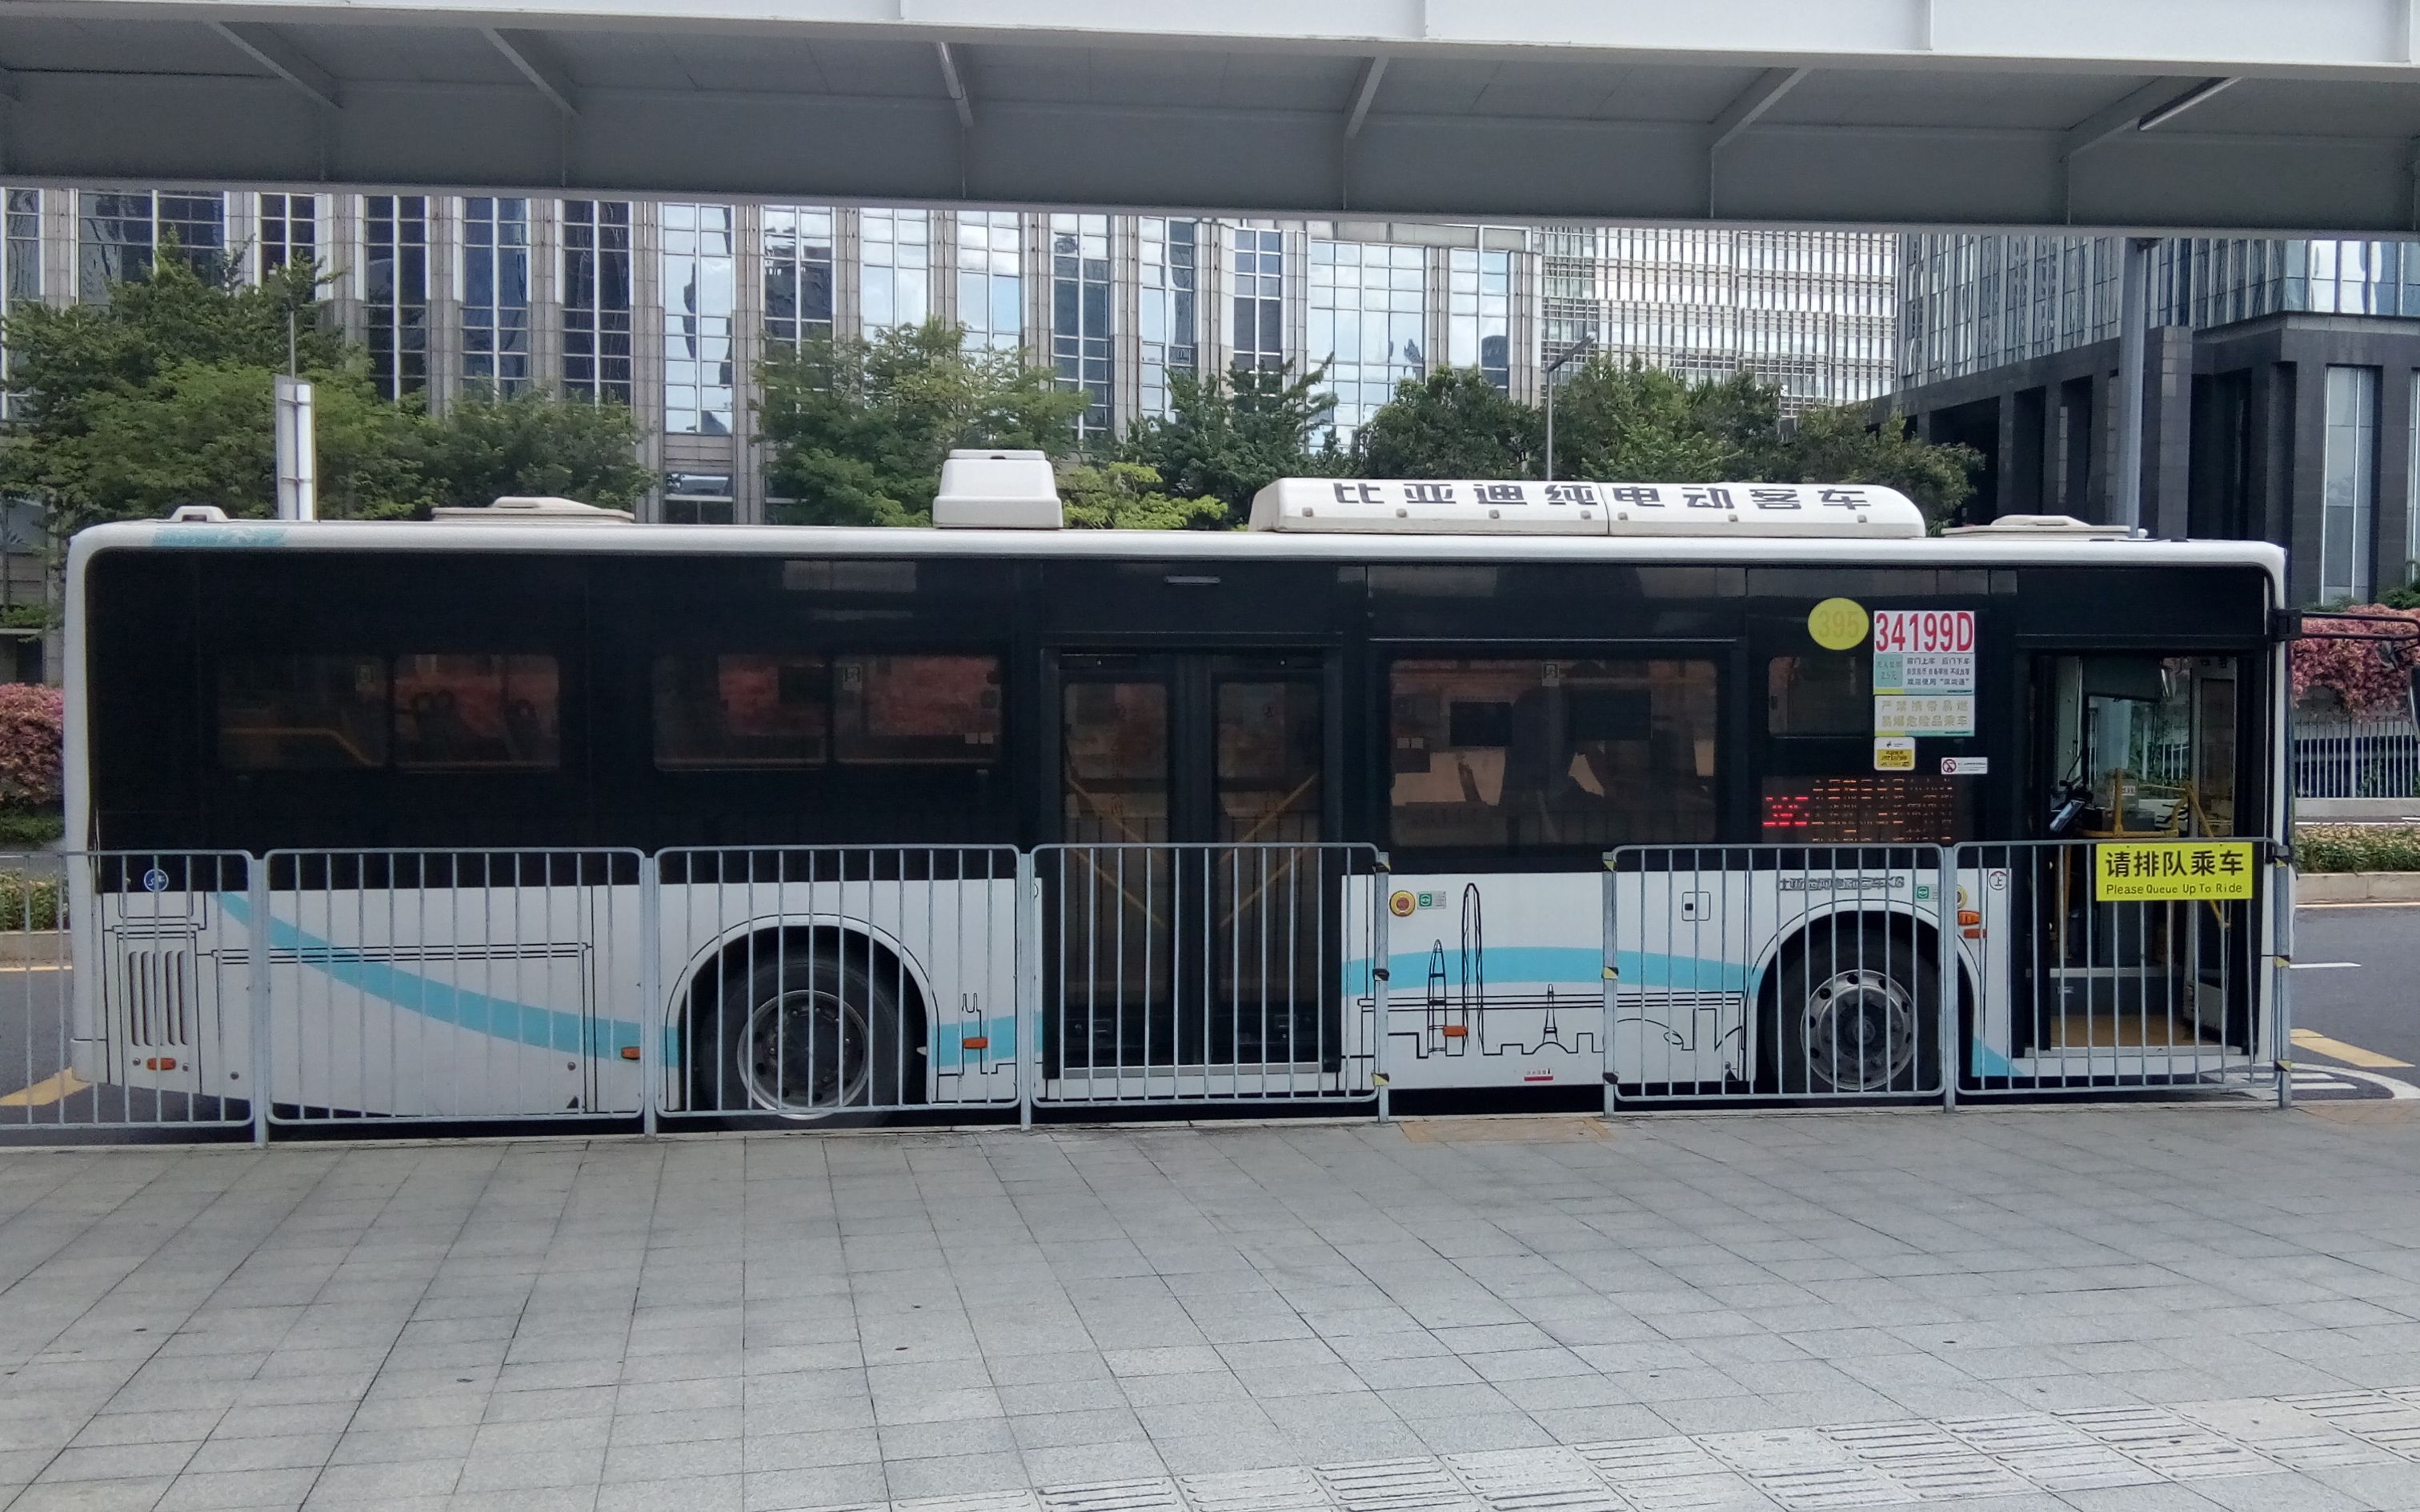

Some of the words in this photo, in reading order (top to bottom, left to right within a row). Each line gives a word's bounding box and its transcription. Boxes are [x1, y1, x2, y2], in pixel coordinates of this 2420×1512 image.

[1332, 482, 1871, 510] 比亚迪纯电动客车
[1817, 610, 1859, 638] 395
[1876, 612, 1973, 651] 34199D
[1881, 714, 1968, 727] 易爆危险品乘车
[2105, 850, 2244, 878] 请排队乘车
[2106, 883, 2144, 894] Please
[2146, 883, 2178, 894] Queue
[2182, 883, 2196, 895] Up
[2199, 882, 2211, 893] To
[2216, 882, 2242, 893] Ride
